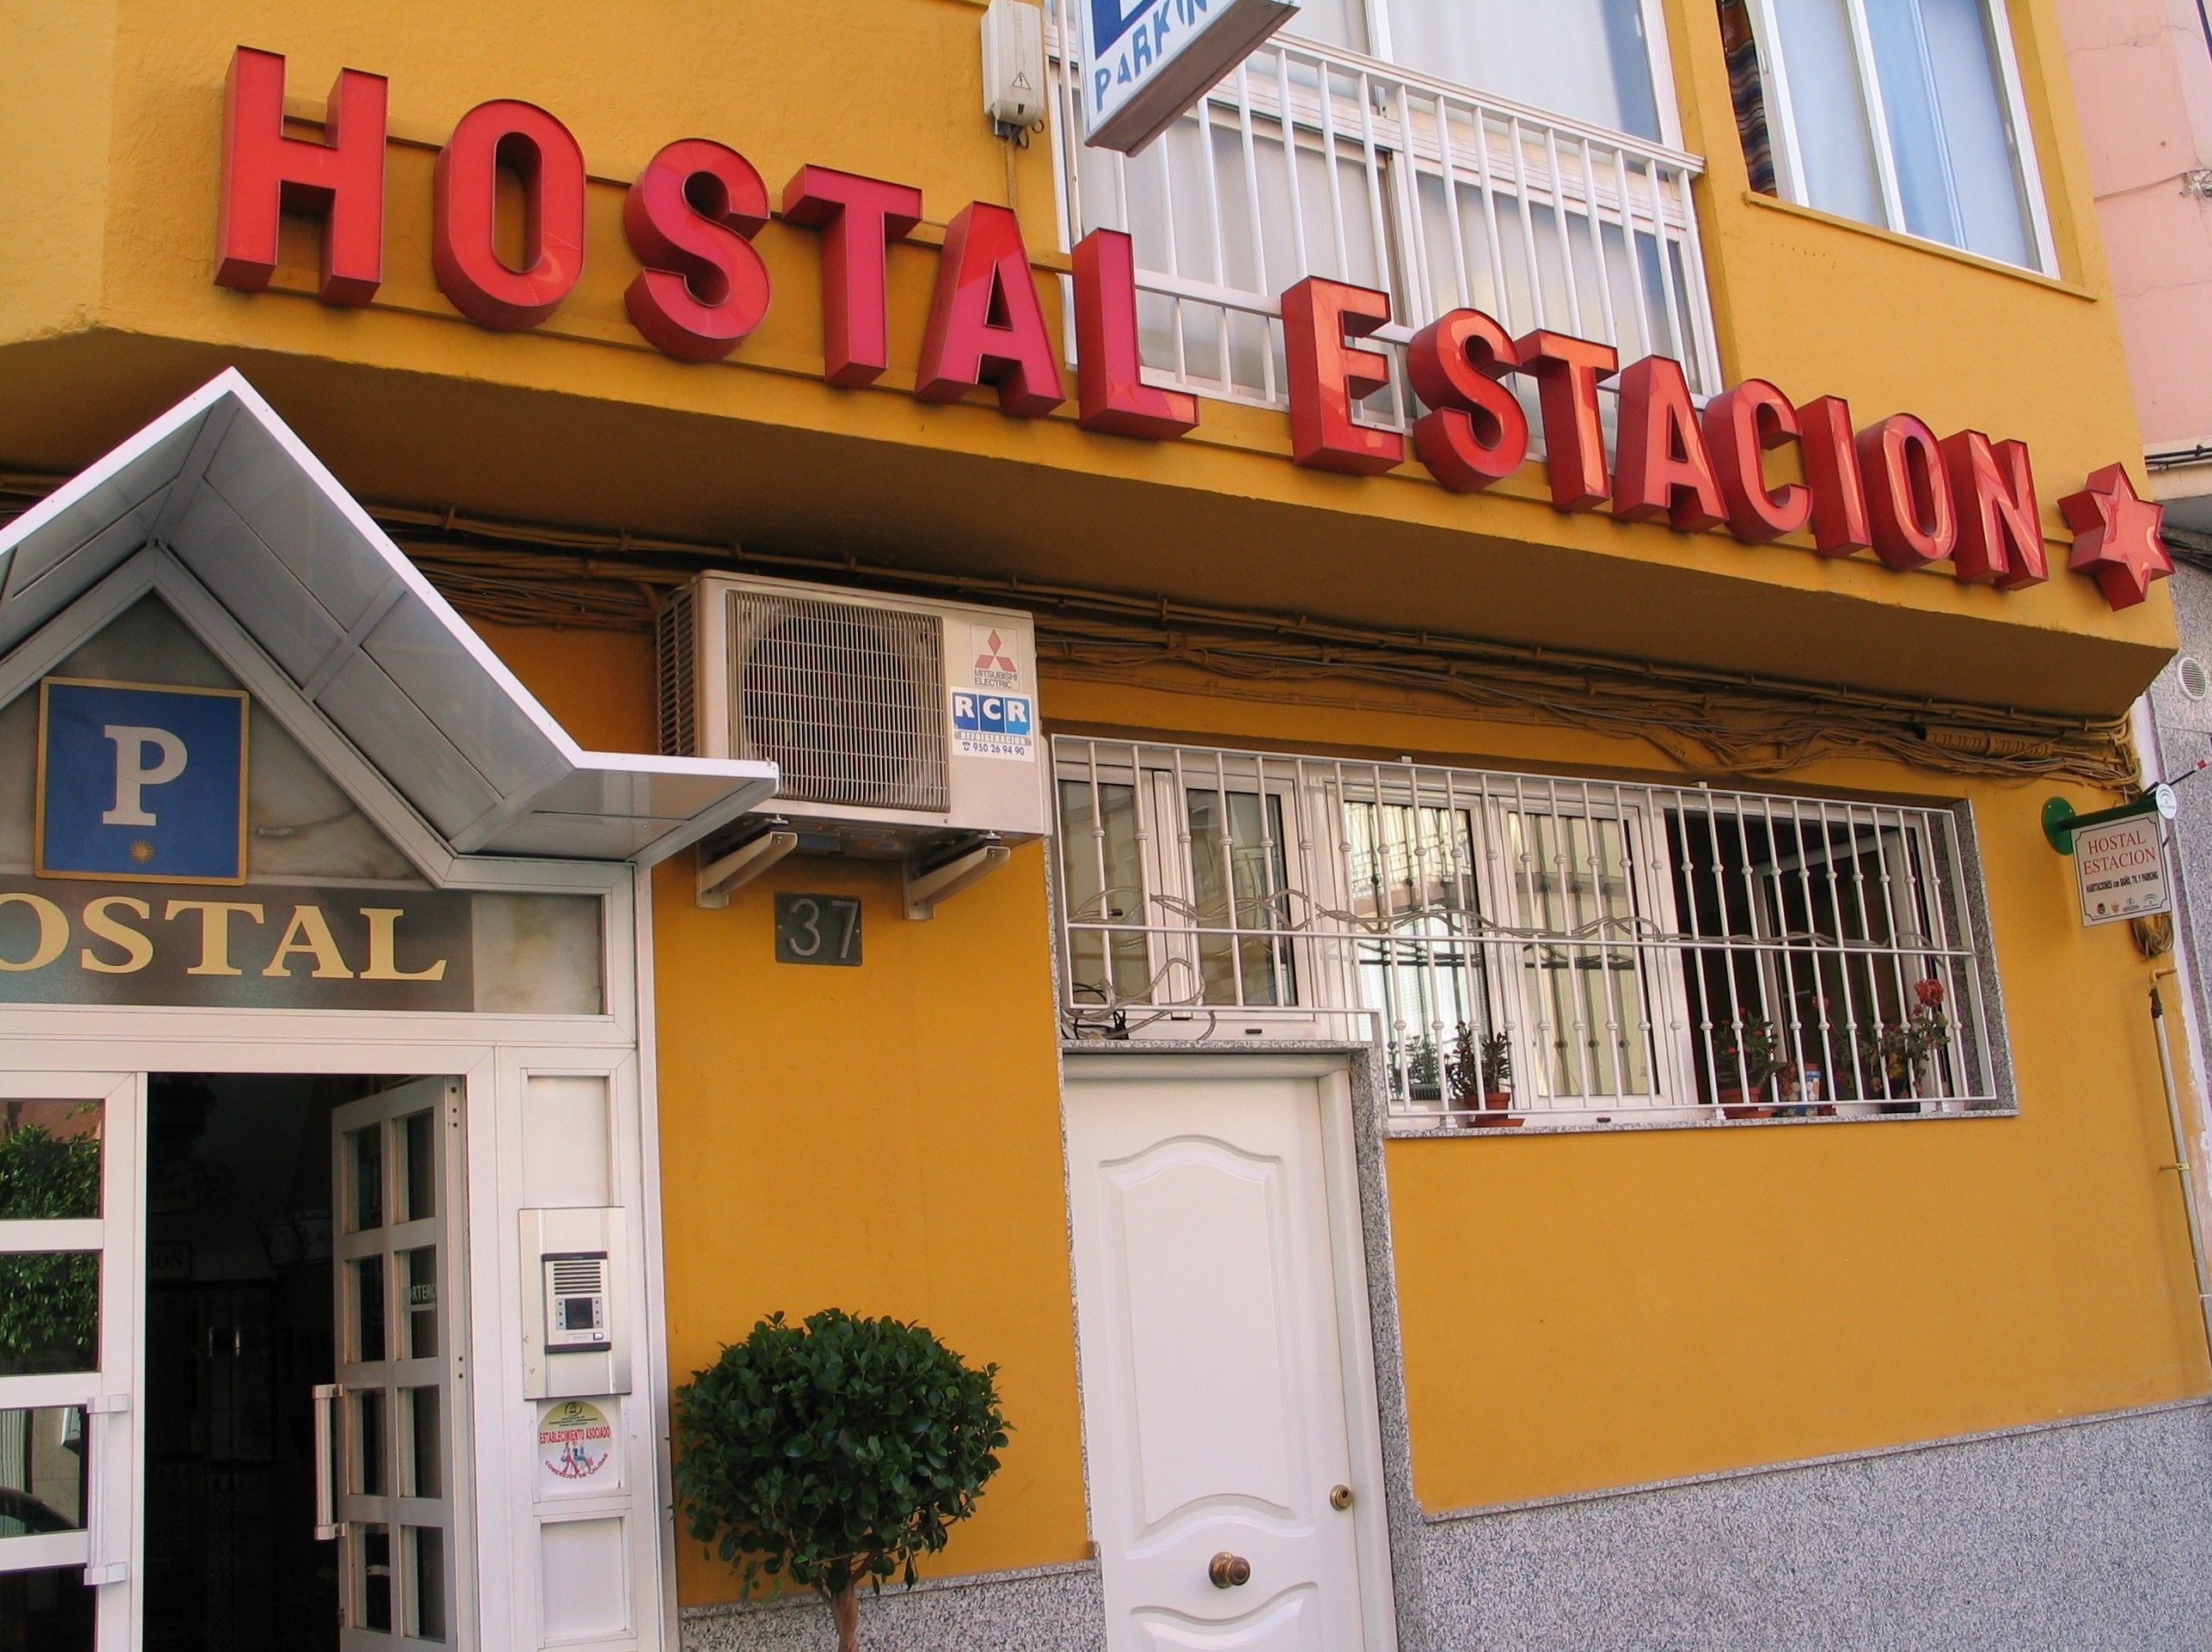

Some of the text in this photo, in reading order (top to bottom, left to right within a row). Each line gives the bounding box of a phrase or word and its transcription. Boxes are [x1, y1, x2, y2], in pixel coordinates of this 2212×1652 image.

[215, 46, 2049, 591] HOSTAL ESTACION
[974, 669, 1018, 682] MITSUBISHI
[974, 677, 1013, 688] ELECTRIC
[954, 695, 1027, 723] RCR
[960, 731, 1026, 745] REFRIGERACION
[972, 743, 1025, 756] 950 26 94 90
[101, 724, 188, 827] P
[2087, 830, 2147, 855] HOSTAL
[2083, 847, 2156, 875] ESTACION
[788, 898, 859, 958] 37
